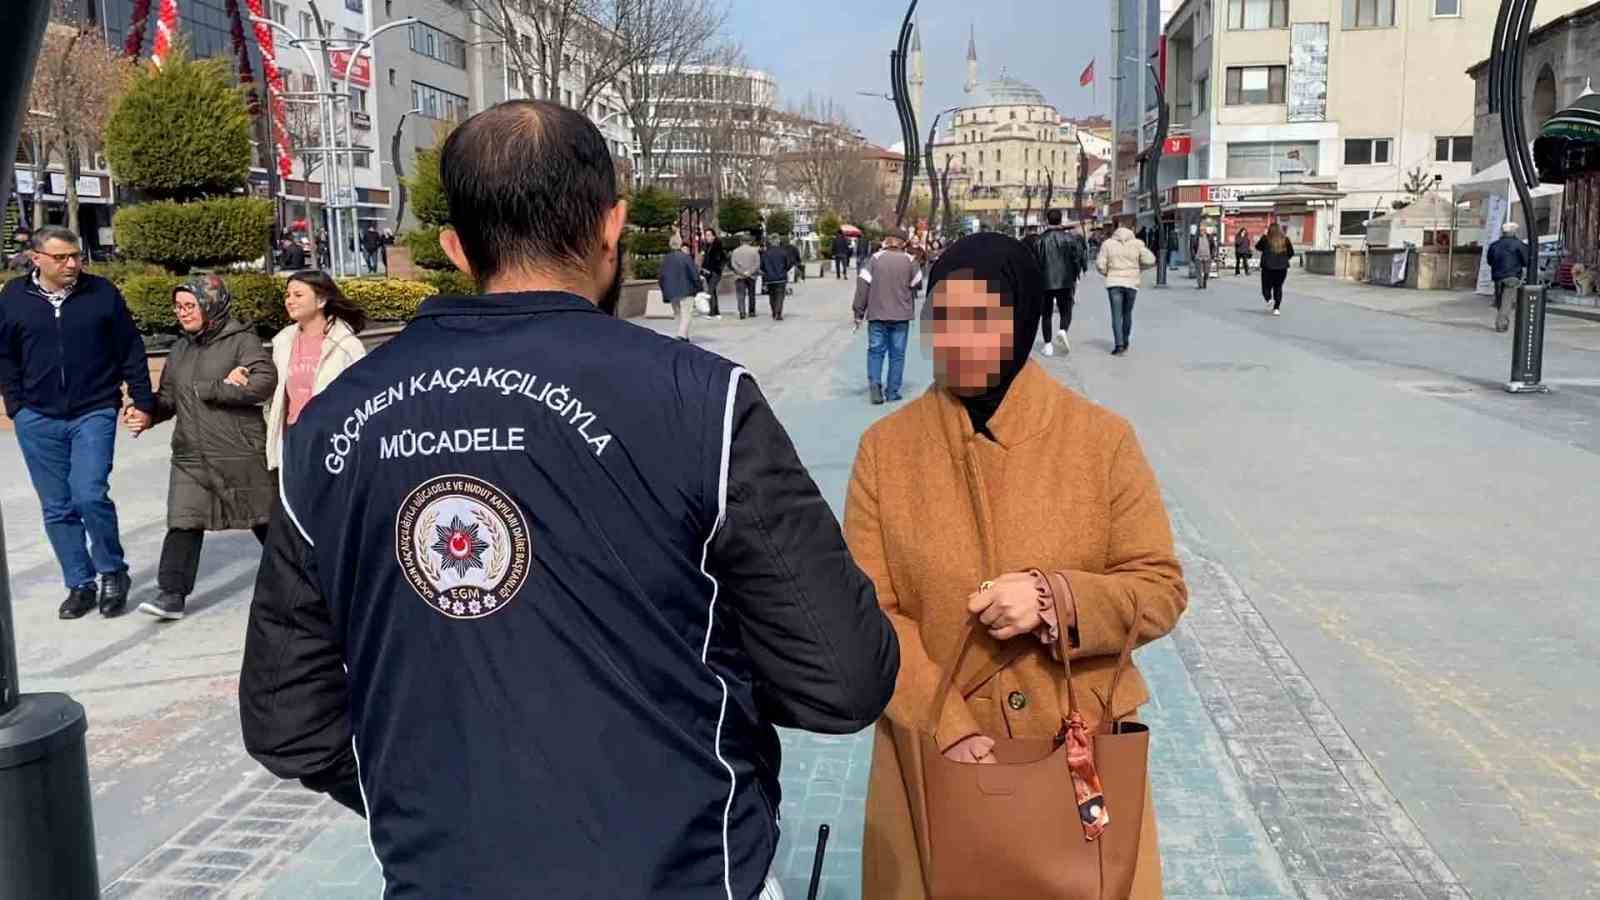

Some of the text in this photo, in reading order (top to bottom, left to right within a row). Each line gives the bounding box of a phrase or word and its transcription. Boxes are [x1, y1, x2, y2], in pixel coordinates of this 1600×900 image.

[325, 367, 612, 474] GÖÇMEN KAÇAKÇILIĞIYLA
[379, 427, 525, 459] MÜCADELE
[413, 481, 452, 507] MÜCADELE
[452, 481, 463, 491] VE
[464, 482, 492, 499] HUDUT
[489, 494, 520, 528] KAPILARI
[450, 588, 480, 600] EGM
